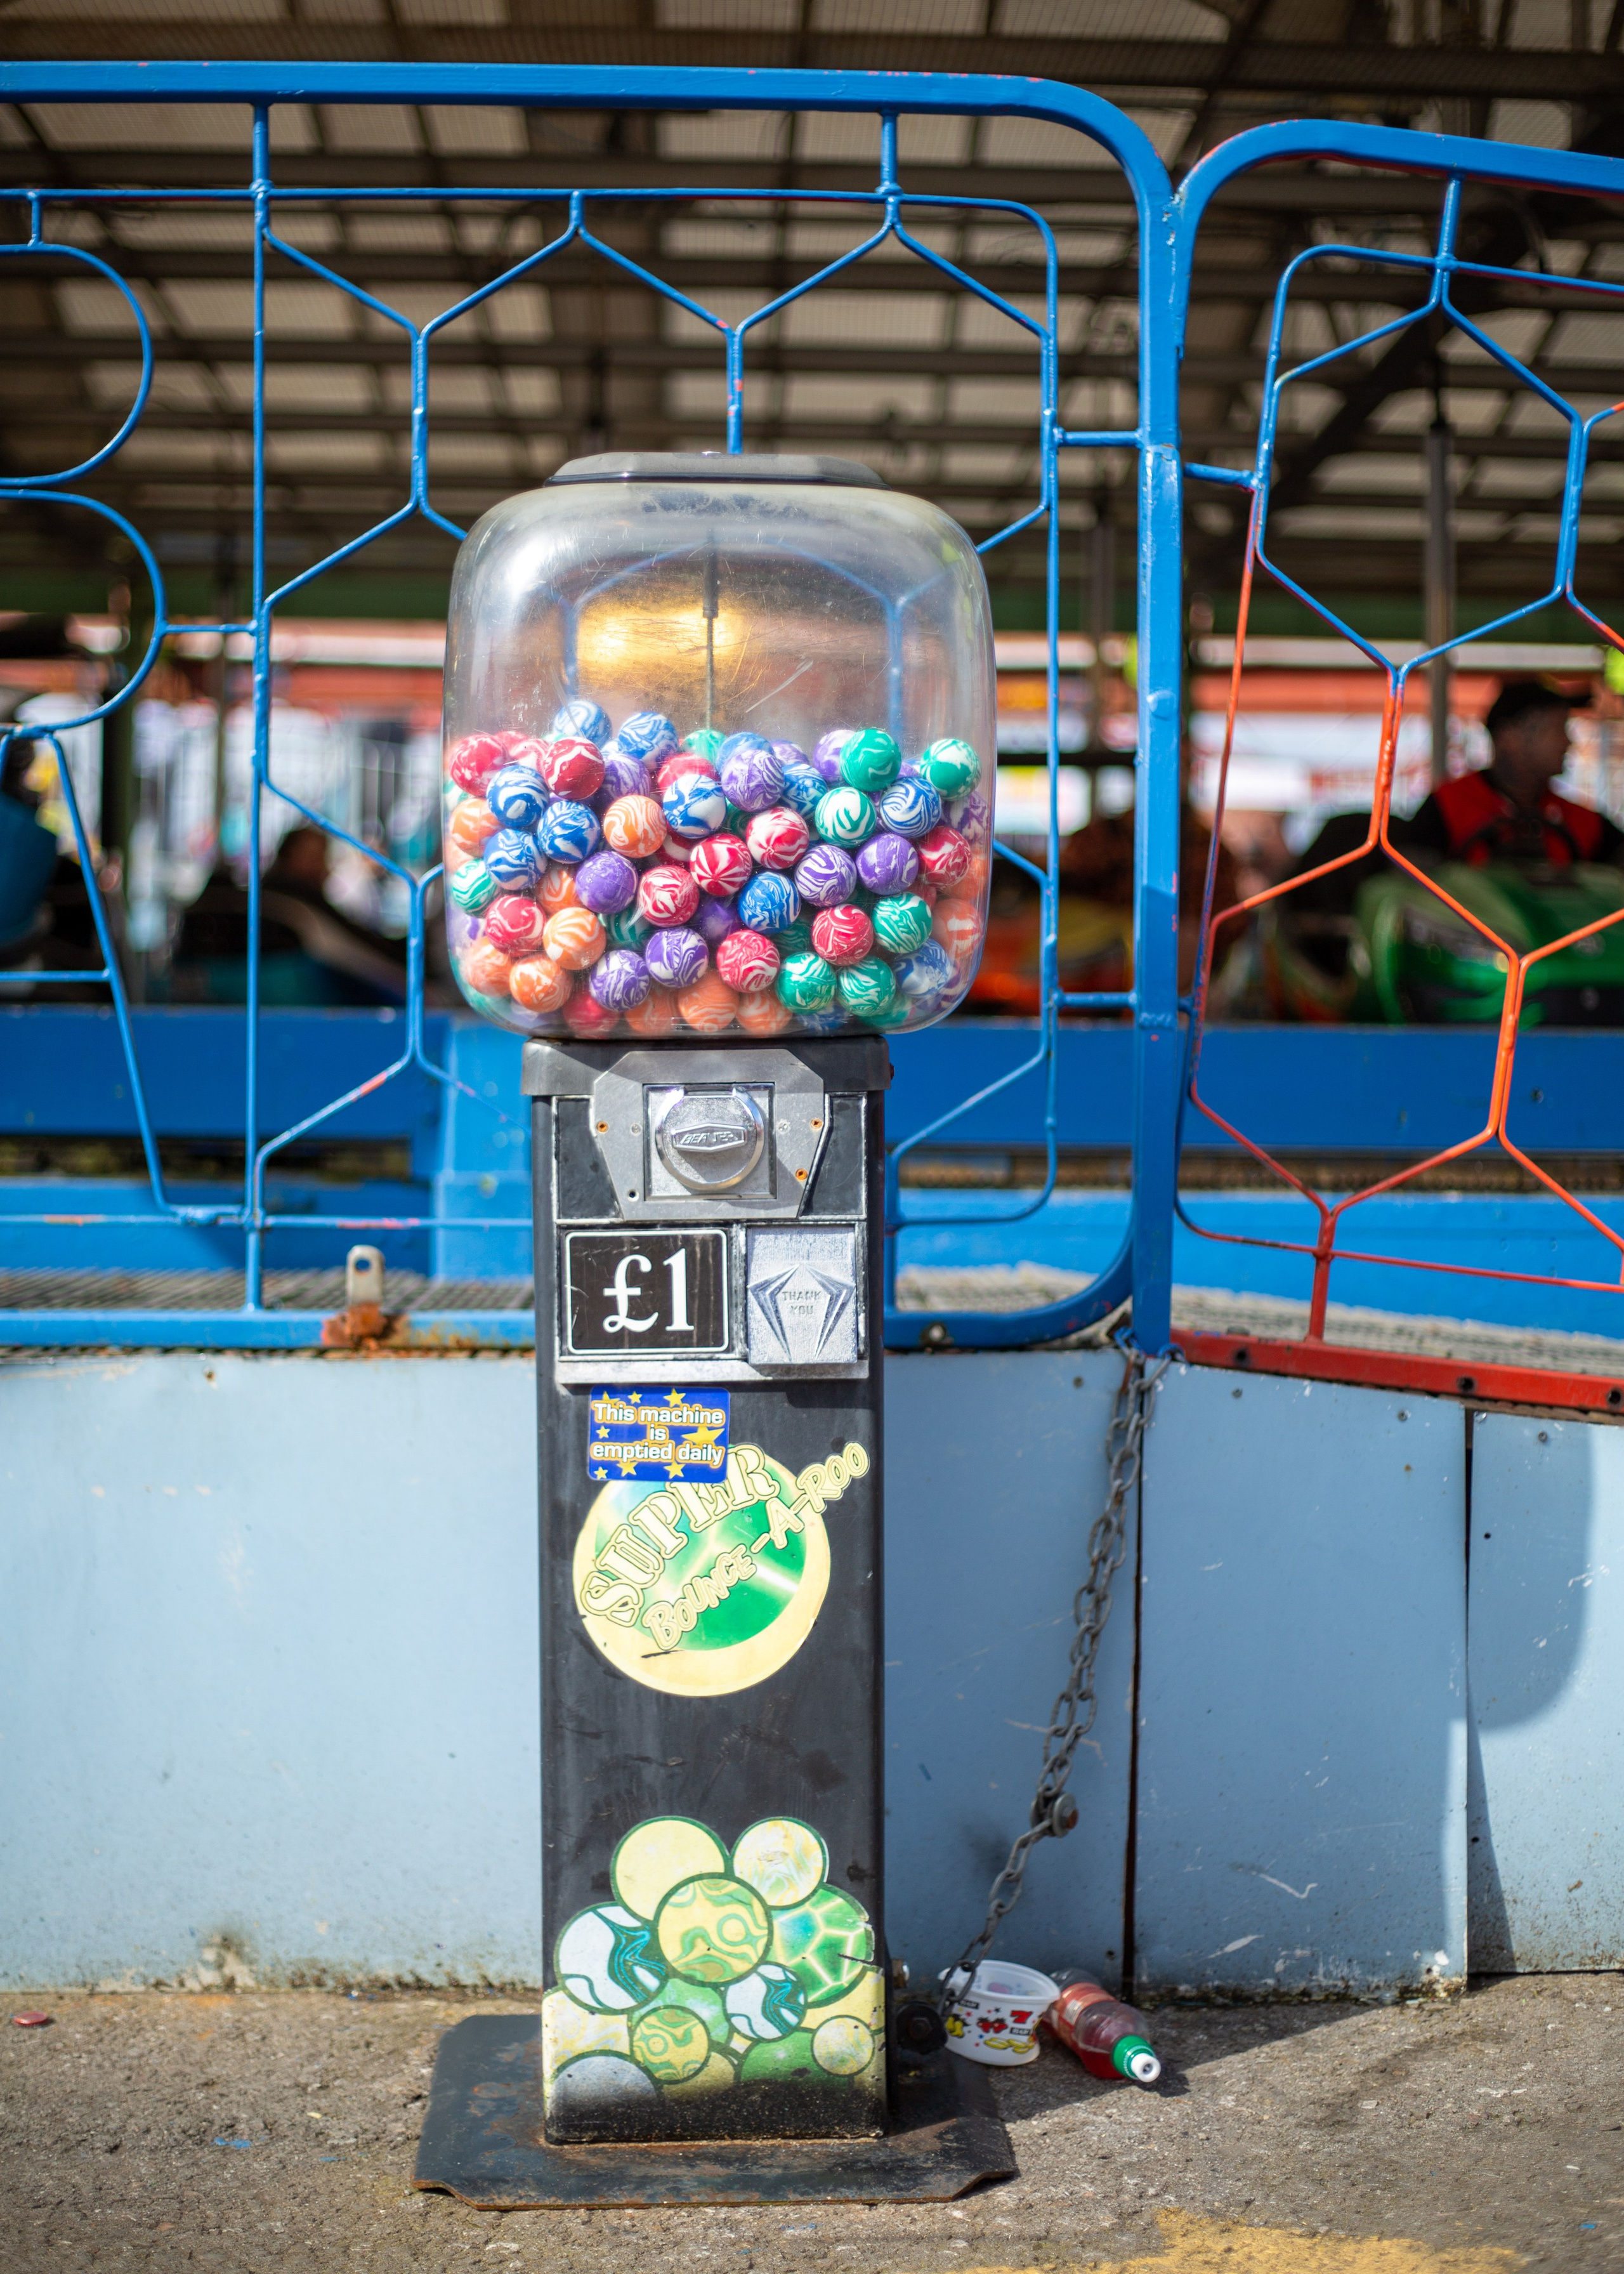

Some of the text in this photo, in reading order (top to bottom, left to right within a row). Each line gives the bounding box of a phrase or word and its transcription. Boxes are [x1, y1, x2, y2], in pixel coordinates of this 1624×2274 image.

[603, 1247, 695, 1333] £1
[782, 1291, 822, 1301] THANK
[790, 1305, 814, 1315] YOU
[593, 1402, 724, 1424] This machine
[650, 1423, 667, 1442] is
[592, 1442, 723, 1466] emptied daily
[580, 1443, 781, 1627] SUPER
[1010, 2009, 1034, 2024] 7
